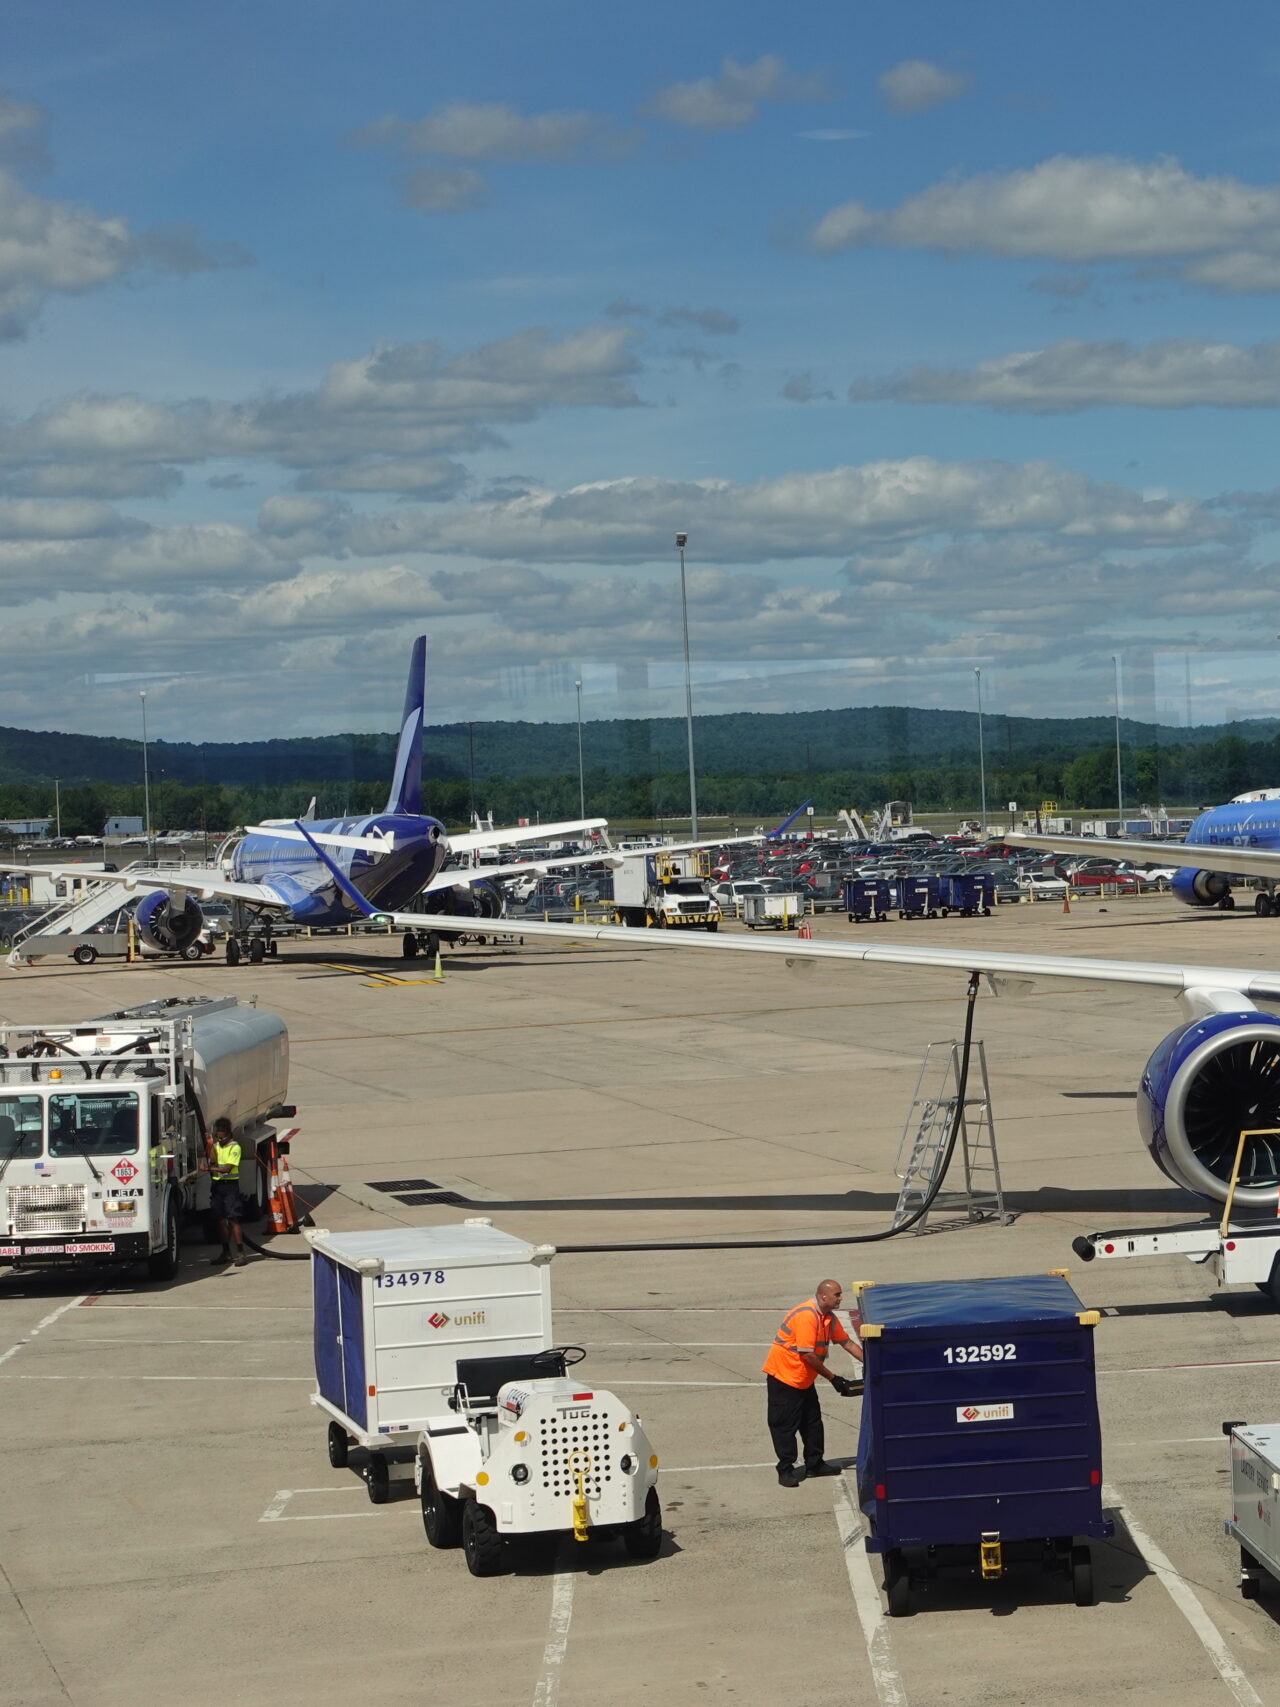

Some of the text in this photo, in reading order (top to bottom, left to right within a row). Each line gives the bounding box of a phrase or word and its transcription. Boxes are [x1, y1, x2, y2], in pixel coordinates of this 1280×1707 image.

[115, 1189, 131, 1197] JET
[79, 1243, 114, 1252] SMOKING
[375, 1270, 445, 1288] 134978
[454, 1311, 486, 1326] unifi
[943, 1343, 1017, 1364] 132592
[983, 1405, 1009, 1419] unifi
